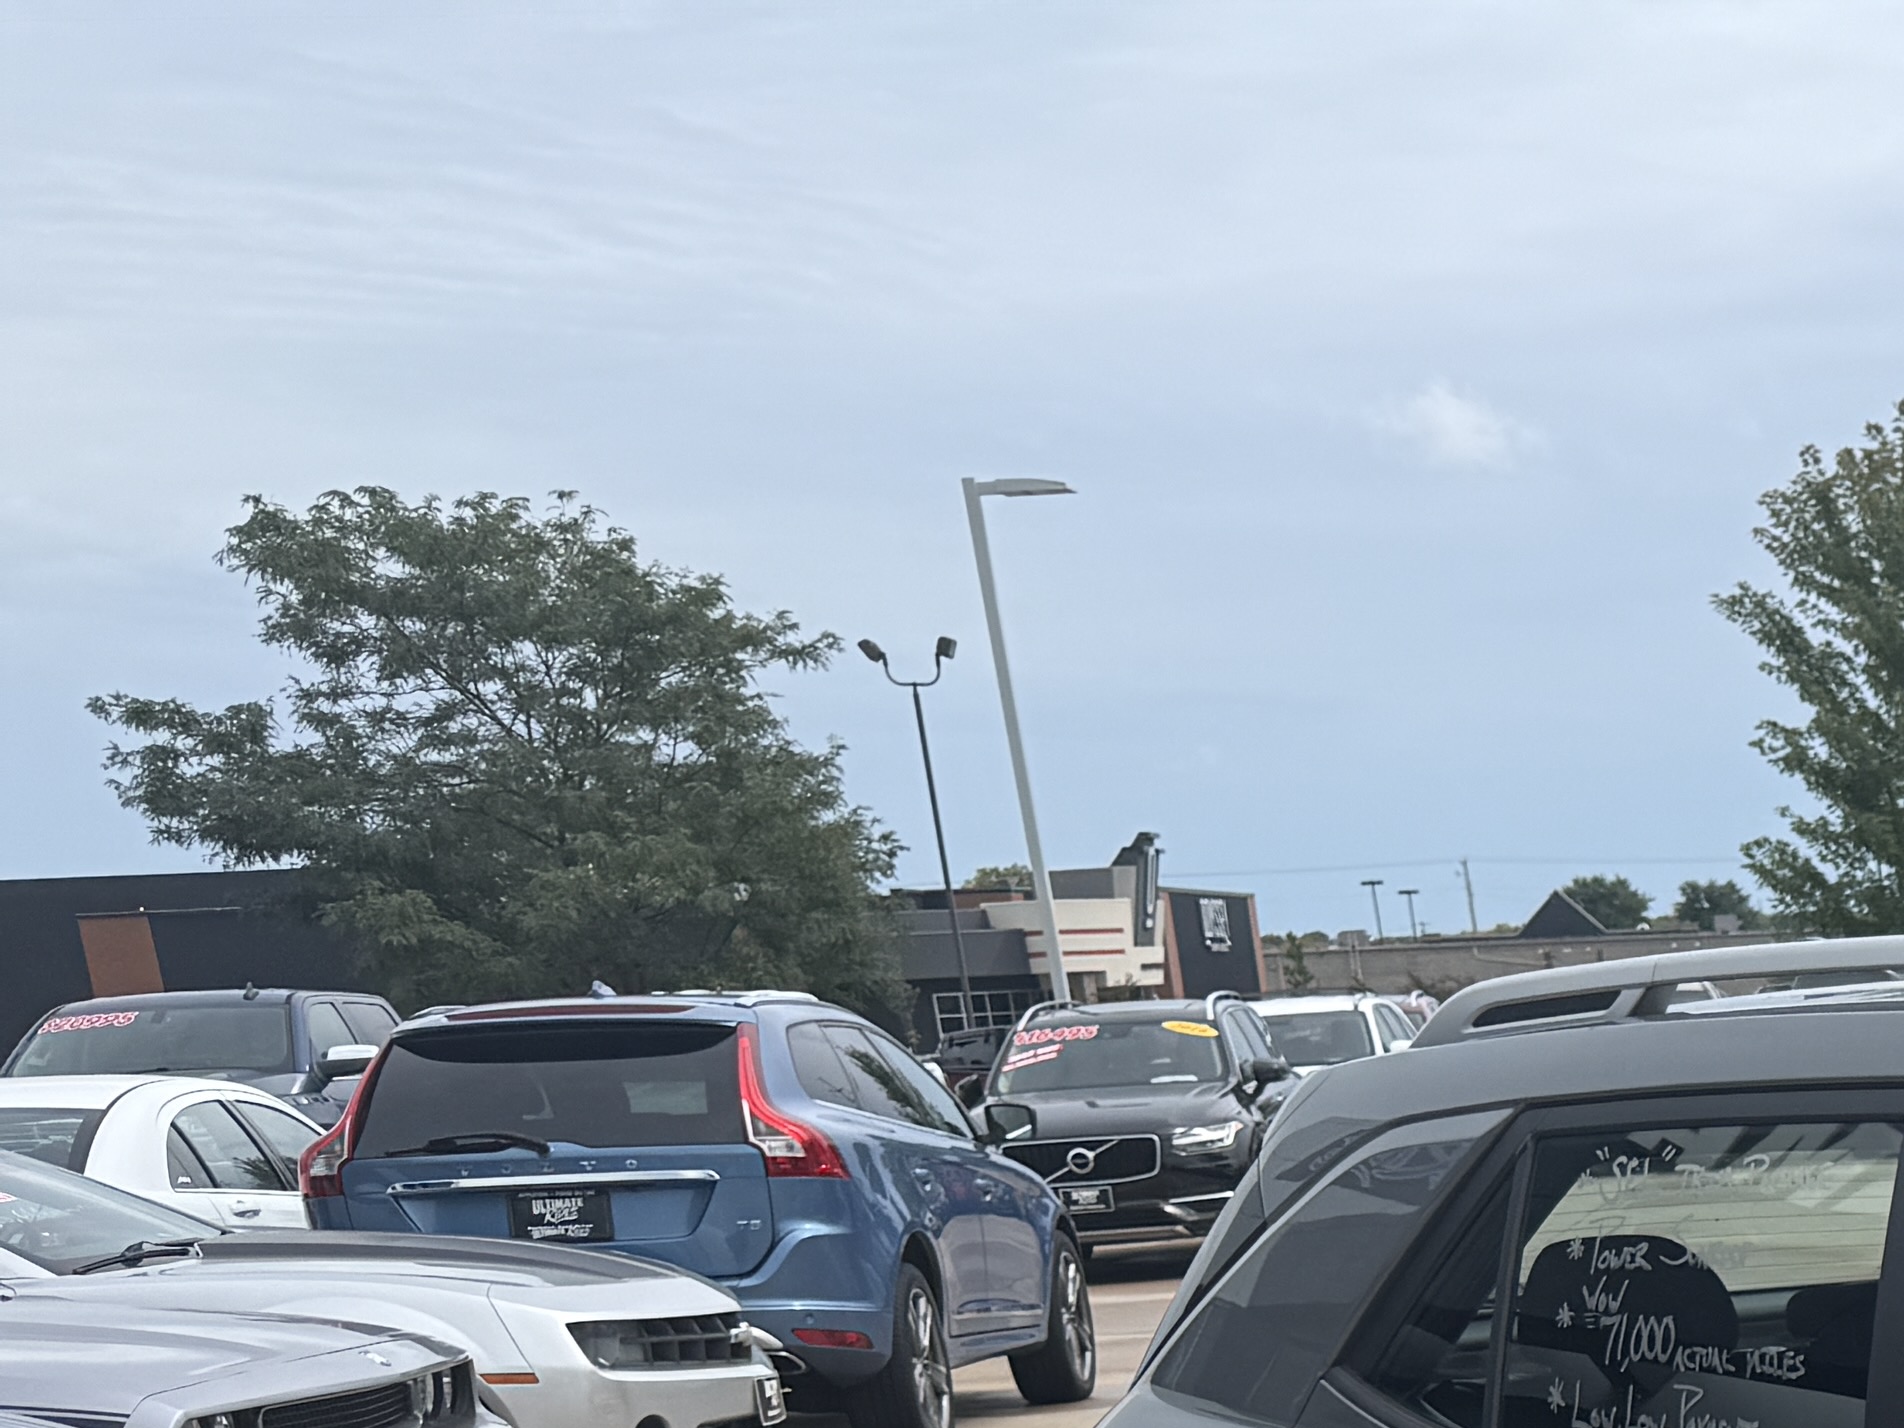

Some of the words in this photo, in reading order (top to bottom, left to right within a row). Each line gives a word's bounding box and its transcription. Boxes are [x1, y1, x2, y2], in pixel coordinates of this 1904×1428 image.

[456, 1158, 638, 1177] VOLVO
[1600, 1313, 1675, 1373] 71,000
[1673, 1345, 1736, 1374] ACTUAL
[1733, 1345, 1806, 1380] MILES
